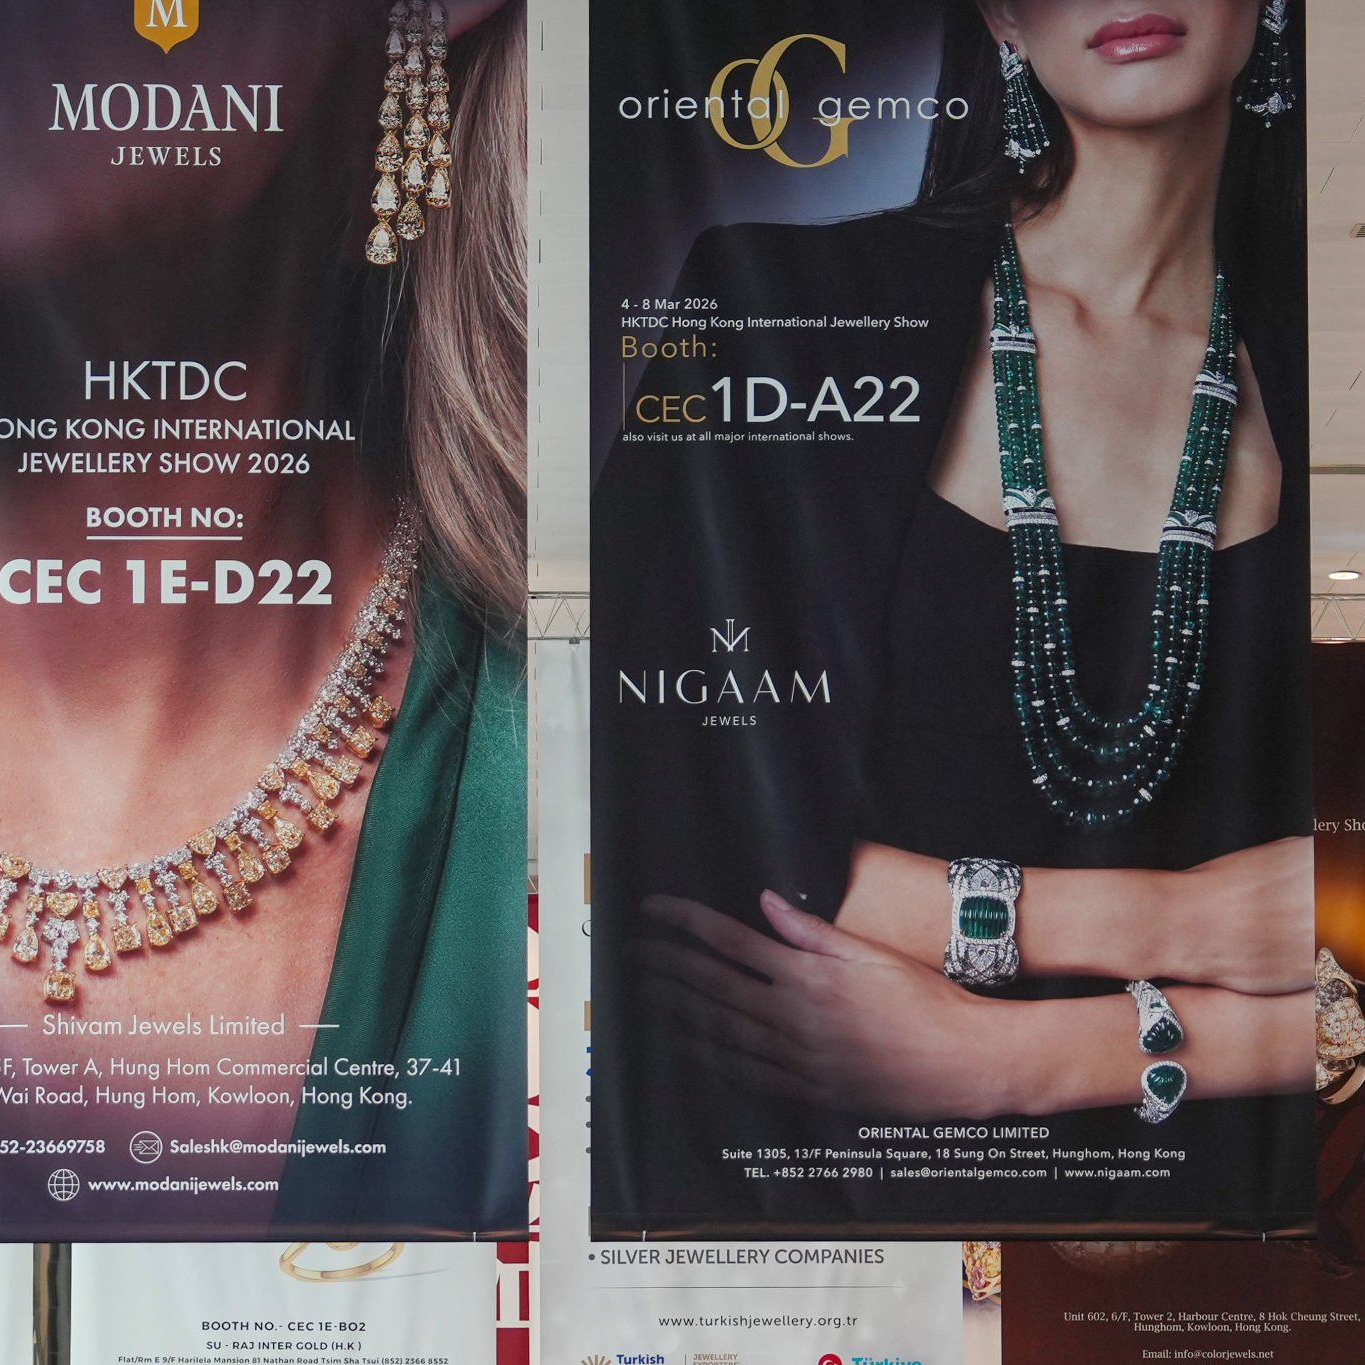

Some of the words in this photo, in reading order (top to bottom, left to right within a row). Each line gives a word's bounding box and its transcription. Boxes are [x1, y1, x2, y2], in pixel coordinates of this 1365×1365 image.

[49, 83, 283, 132] MODANI
[619, 88, 785, 120] oriental
[818, 97, 969, 127] gemco
[110, 146, 222, 167] JEWELS
[620, 298, 630, 310] 4
[642, 298, 651, 311] 8
[654, 298, 681, 310] Mar
[684, 297, 718, 310] 2026
[622, 333, 717, 359] Booth:
[85, 360, 247, 402] HKTDC
[635, 394, 707, 424] CEC
[711, 375, 921, 423] 1D-A22
[66, 417, 146, 440] KONG
[154, 418, 356, 441] INTERNATIONAL
[17, 452, 153, 474] JEWELLERY
[159, 452, 241, 474] SHOW
[247, 452, 310, 475] 2026
[86, 506, 182, 528] BOOTH
[191, 507, 244, 529] NO:
[126, 559, 333, 605] 1E-D22
[619, 669, 831, 705] NIGAAM
[701, 715, 757, 726] JEWELS
[1313, 817, 1340, 834] lery
[42, 1012, 122, 1036] Shivam
[128, 1012, 202, 1036] Jewels
[210, 1012, 285, 1036] Limited
[170, 1138, 387, 1158] Saleshk@modanijewels.com
[87, 1175, 279, 1195] www.modanijewels.com
[600, 1249, 661, 1265] SILVER
[665, 1248, 771, 1265] JEWELLERY
[774, 1248, 885, 1265] COMPANIES
[658, 1314, 858, 1329] www.turkishjewellery.org.tr
[616, 1353, 665, 1365] Turkish
[692, 1353, 738, 1361] JEWELLERY
[1142, 1349, 1172, 1359] Email:
[1174, 1349, 1274, 1361] info@colorjewels.net
